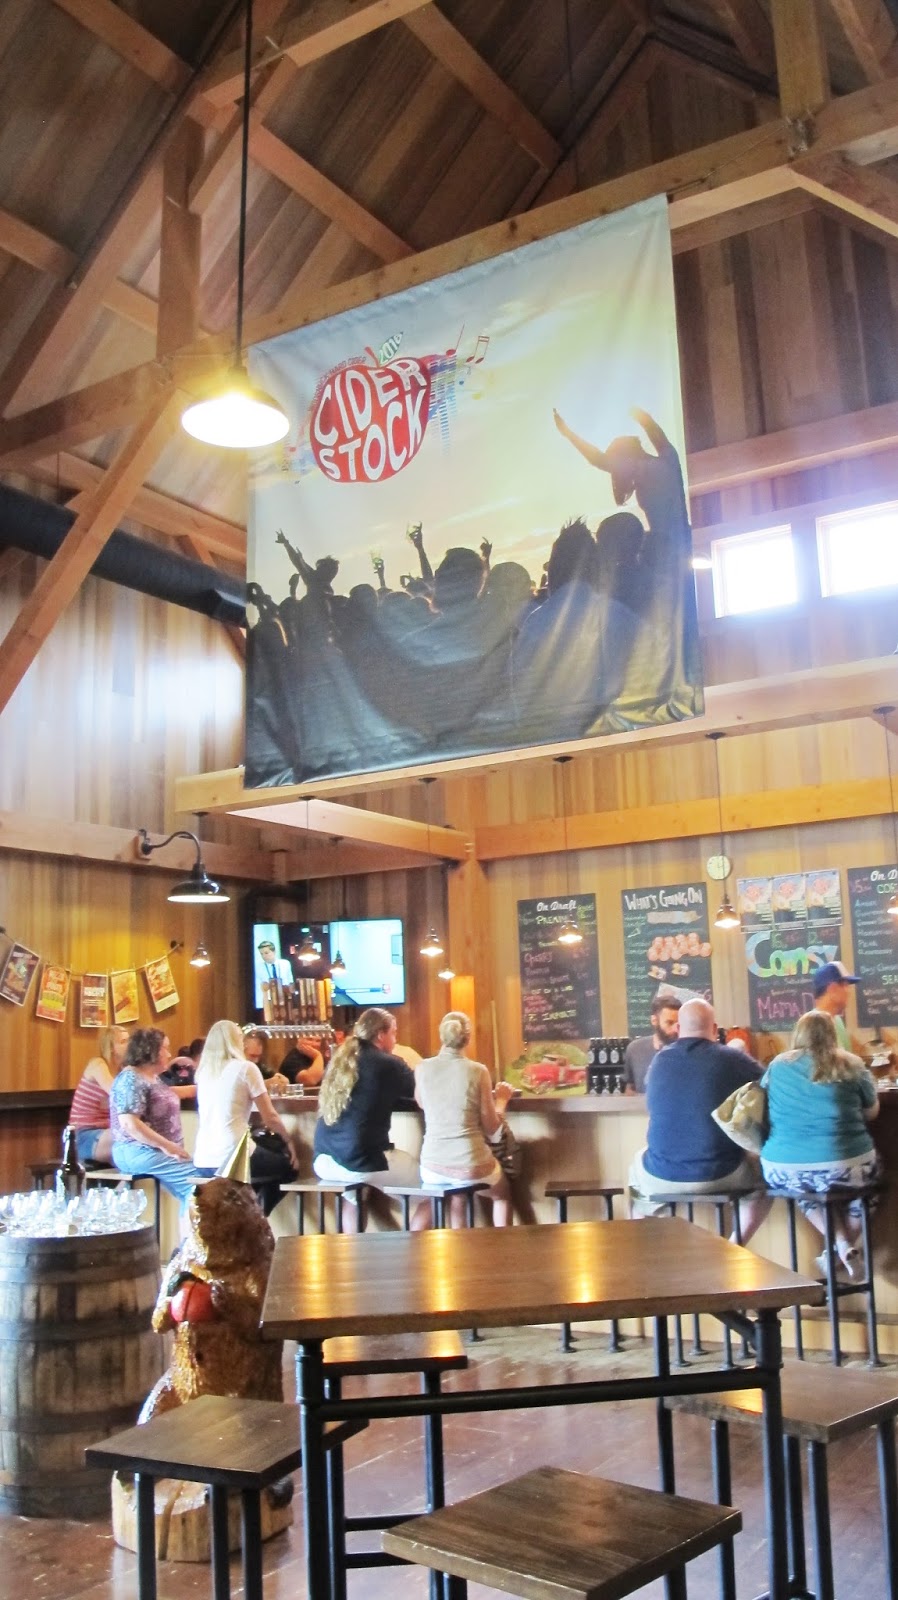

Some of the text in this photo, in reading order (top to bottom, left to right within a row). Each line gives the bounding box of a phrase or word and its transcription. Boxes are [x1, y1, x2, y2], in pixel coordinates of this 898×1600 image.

[314, 358, 427, 447] CIDER
[319, 389, 427, 481] STOCK
[870, 870, 886, 881] On
